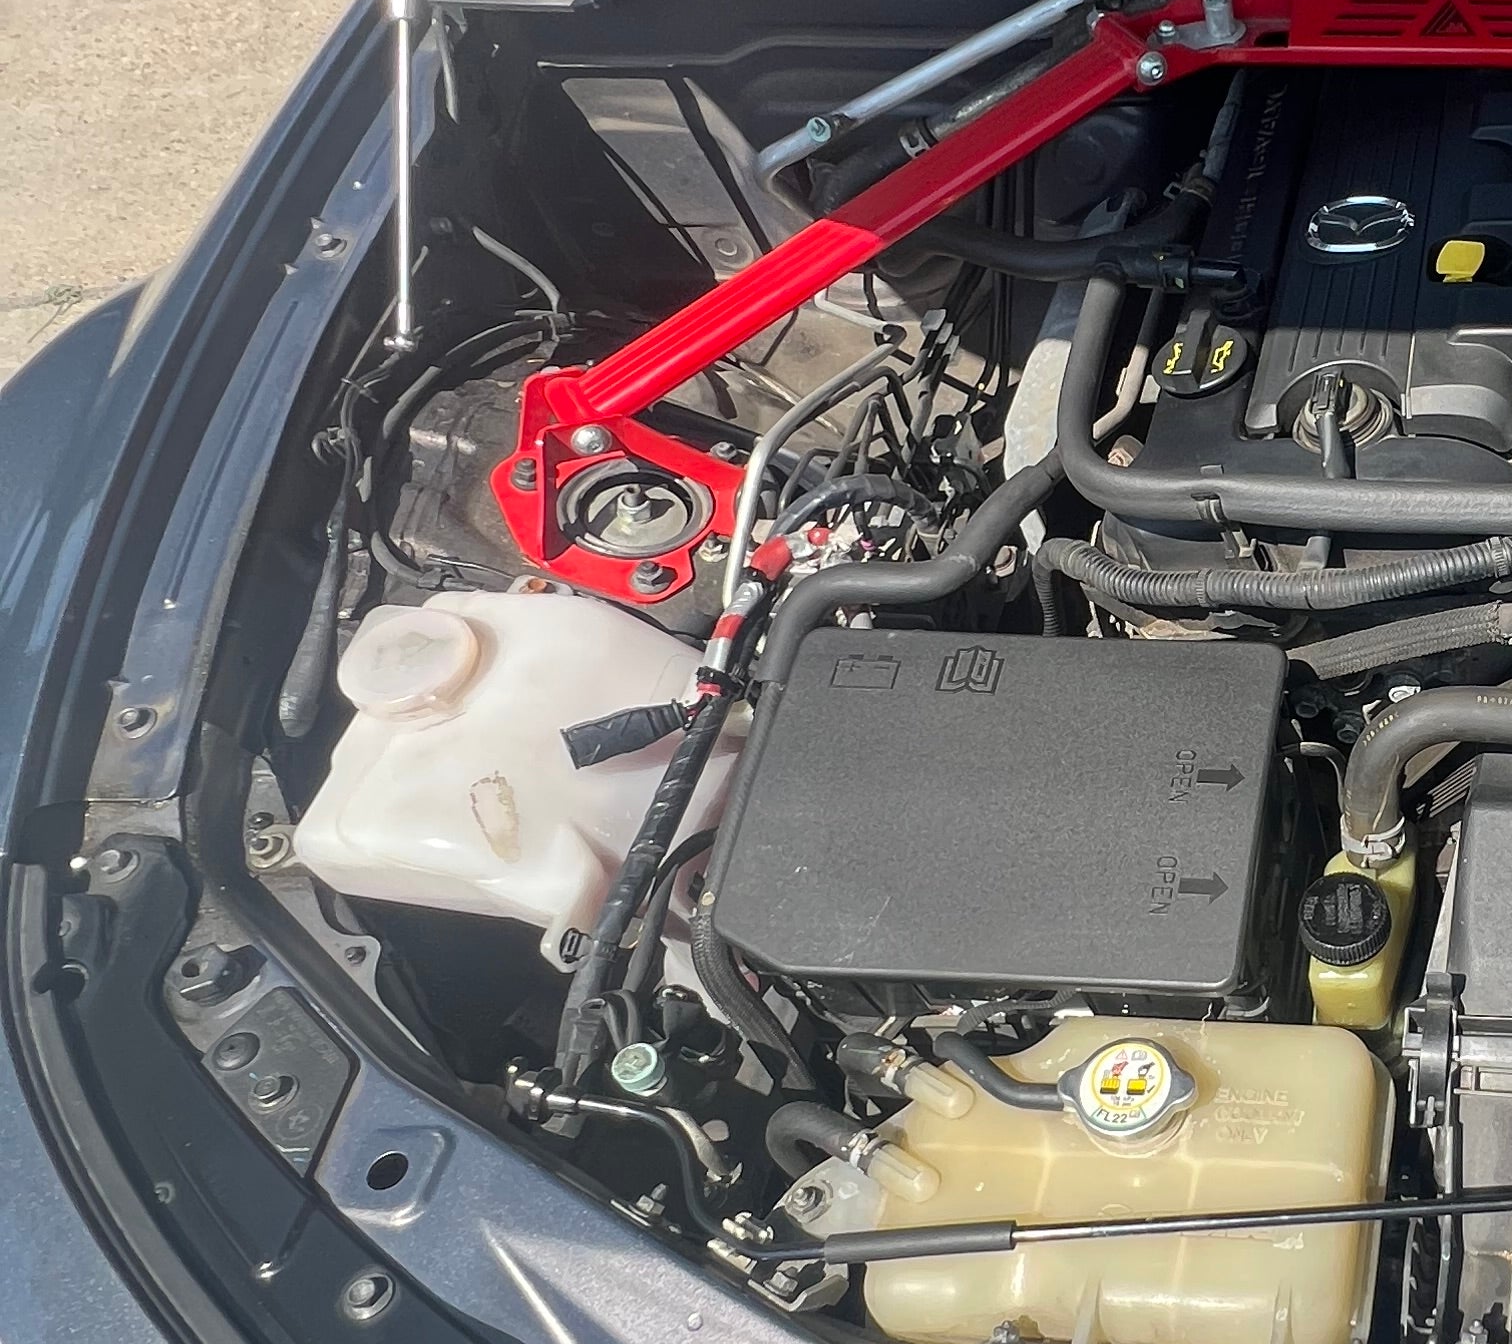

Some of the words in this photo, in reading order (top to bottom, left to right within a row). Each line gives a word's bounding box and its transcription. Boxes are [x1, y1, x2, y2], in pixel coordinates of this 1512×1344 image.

[1168, 749, 1197, 804] OPEN
[1148, 856, 1179, 916] OPEN
[1215, 1087, 1289, 1107] ENGINE
[1096, 1108, 1127, 1124] FL22
